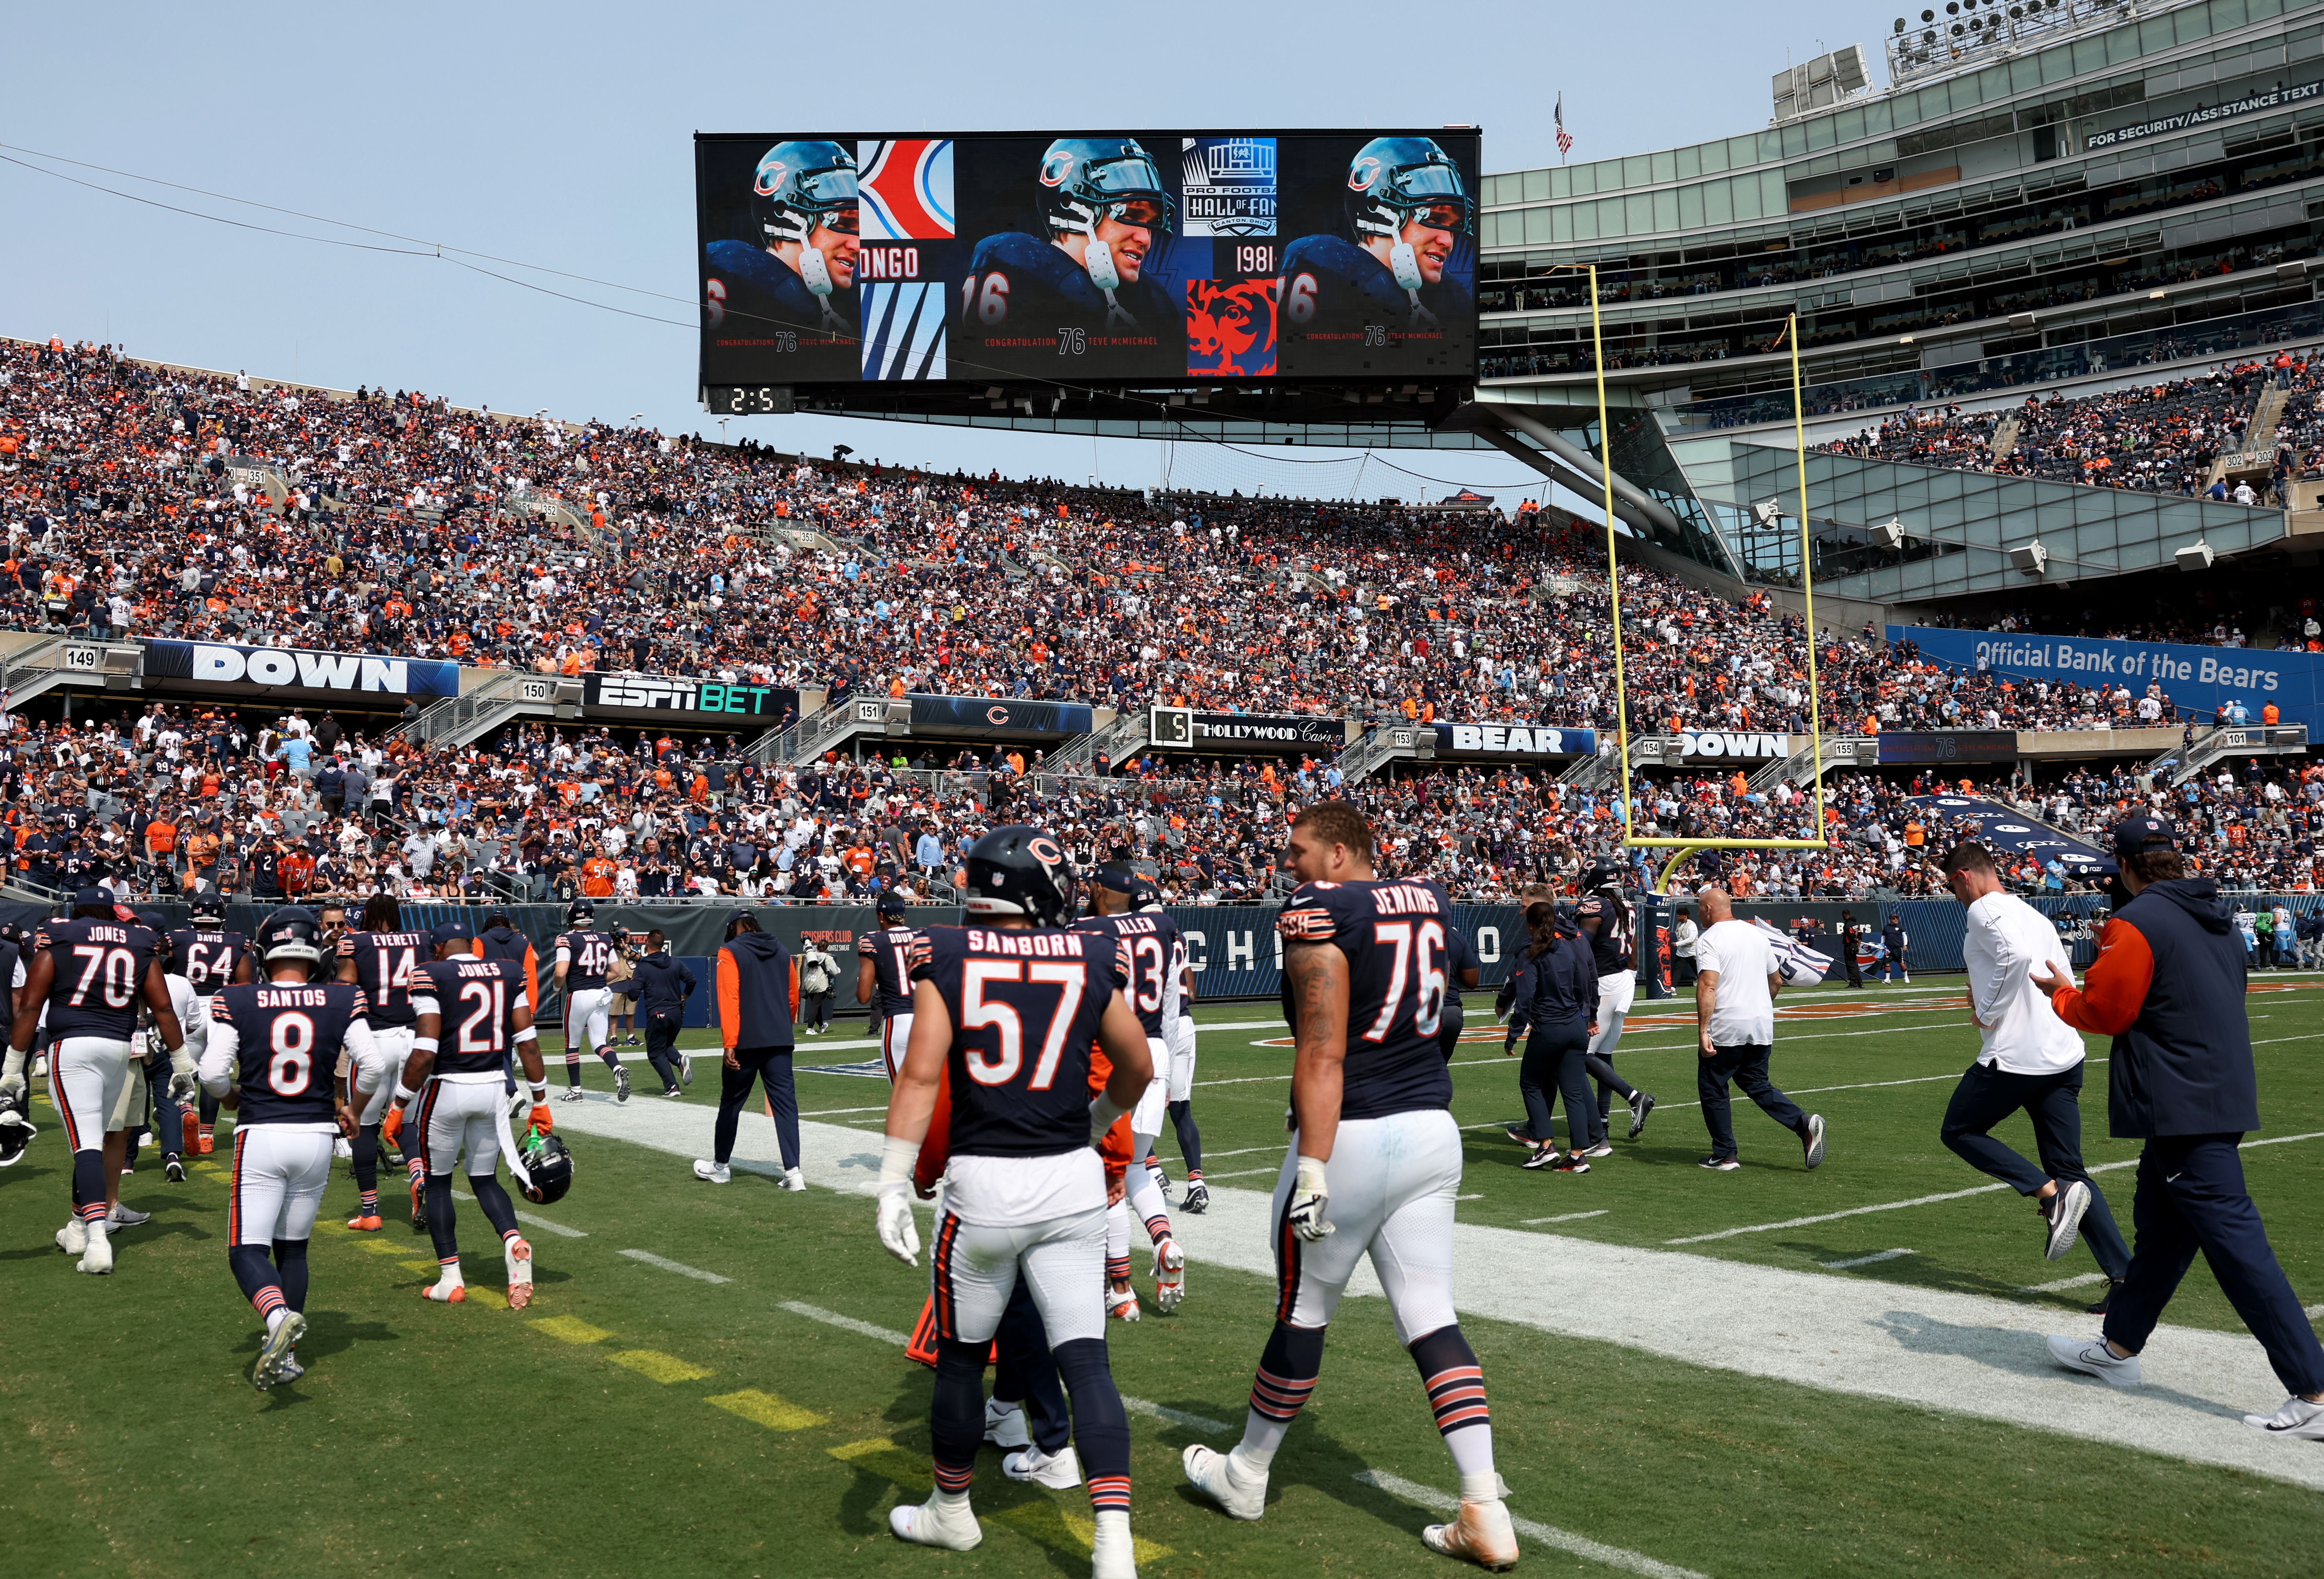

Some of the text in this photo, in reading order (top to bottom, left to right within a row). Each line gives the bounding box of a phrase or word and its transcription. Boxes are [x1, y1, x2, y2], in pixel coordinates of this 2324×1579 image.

[2089, 133, 2116, 147] FOR
[2281, 82, 2319, 100] TEXT
[1190, 198, 1236, 215] HALL
[1236, 199, 1247, 209] OF
[1236, 245, 1273, 272] 1981
[776, 332, 797, 352] 76
[985, 327, 1158, 354] CONGRATULATION 76 TEVE McMICHAEL
[1365, 325, 1385, 346] 76
[2227, 455, 2242, 467] 302
[2257, 452, 2274, 462] 303
[250, 471, 264, 482] 351
[543, 505, 556, 516] 352
[802, 532, 813, 542] 353
[62, 583, 72, 592] 23
[1565, 582, 1576, 591] 356
[312, 595, 318, 604] 18
[68, 650, 94, 666] 149
[192, 645, 407, 694] DOWN
[1024, 666, 1033, 675] 48
[1976, 640, 2279, 691] Official Bank of the Bears
[524, 685, 545, 697] 150
[598, 677, 770, 715] ESPN BET
[861, 705, 878, 719] 151
[1202, 723, 1297, 741] HOLLYWOOD
[1453, 725, 1564, 753] BEAR
[2229, 733, 2245, 745] 101
[166, 738, 177, 750] 54
[1397, 734, 1410, 745] 153
[533, 749, 545, 759] 54
[644, 746, 652, 757] 34
[1644, 742, 1658, 753] 154
[1836, 745, 1852, 754] 155
[1936, 737, 1956, 757] 76
[156, 762, 169, 772] 89
[682, 772, 694, 782] 54
[839, 787, 846, 796] 18
[1321, 783, 1328, 791] 34
[567, 791, 575, 801] 18
[752, 790, 765, 802] 34
[60, 813, 76, 828] 76
[603, 835, 612, 848] 85
[1494, 832, 1501, 842] 18
[240, 846, 248, 860] 9
[1077, 843, 1088, 854] 34
[263, 856, 271, 870] 2
[713, 856, 722, 867] 21
[294, 868, 307, 882] 34
[593, 864, 607, 878] 54
[798, 863, 810, 877] 34
[157, 877, 168, 887] 52
[562, 887, 570, 899] 18
[1371, 885, 1439, 915] JENKINS
[1114, 917, 1157, 936] ALLEN
[1836, 922, 1872, 934] Brs
[2243, 918, 2254, 928] 75
[87, 926, 127, 944] JONES
[196, 932, 223, 944] DAVIS
[835, 930, 852, 942] CLUB
[1609, 909, 1636, 955] 49
[371, 933, 420, 947] EVERETT
[967, 930, 1084, 957] SANBORN
[185, 942, 232, 987] 64
[578, 942, 608, 976] 46
[68, 944, 136, 1009] 70
[377, 947, 417, 1006] 14
[458, 962, 501, 977] JONES
[1121, 936, 1165, 1014] 13
[1361, 918, 1446, 1043] 76
[256, 989, 327, 1008] SANTOS
[457, 979, 505, 1054] 21
[960, 958, 1087, 1091] 57
[268, 1010, 315, 1097] 8
